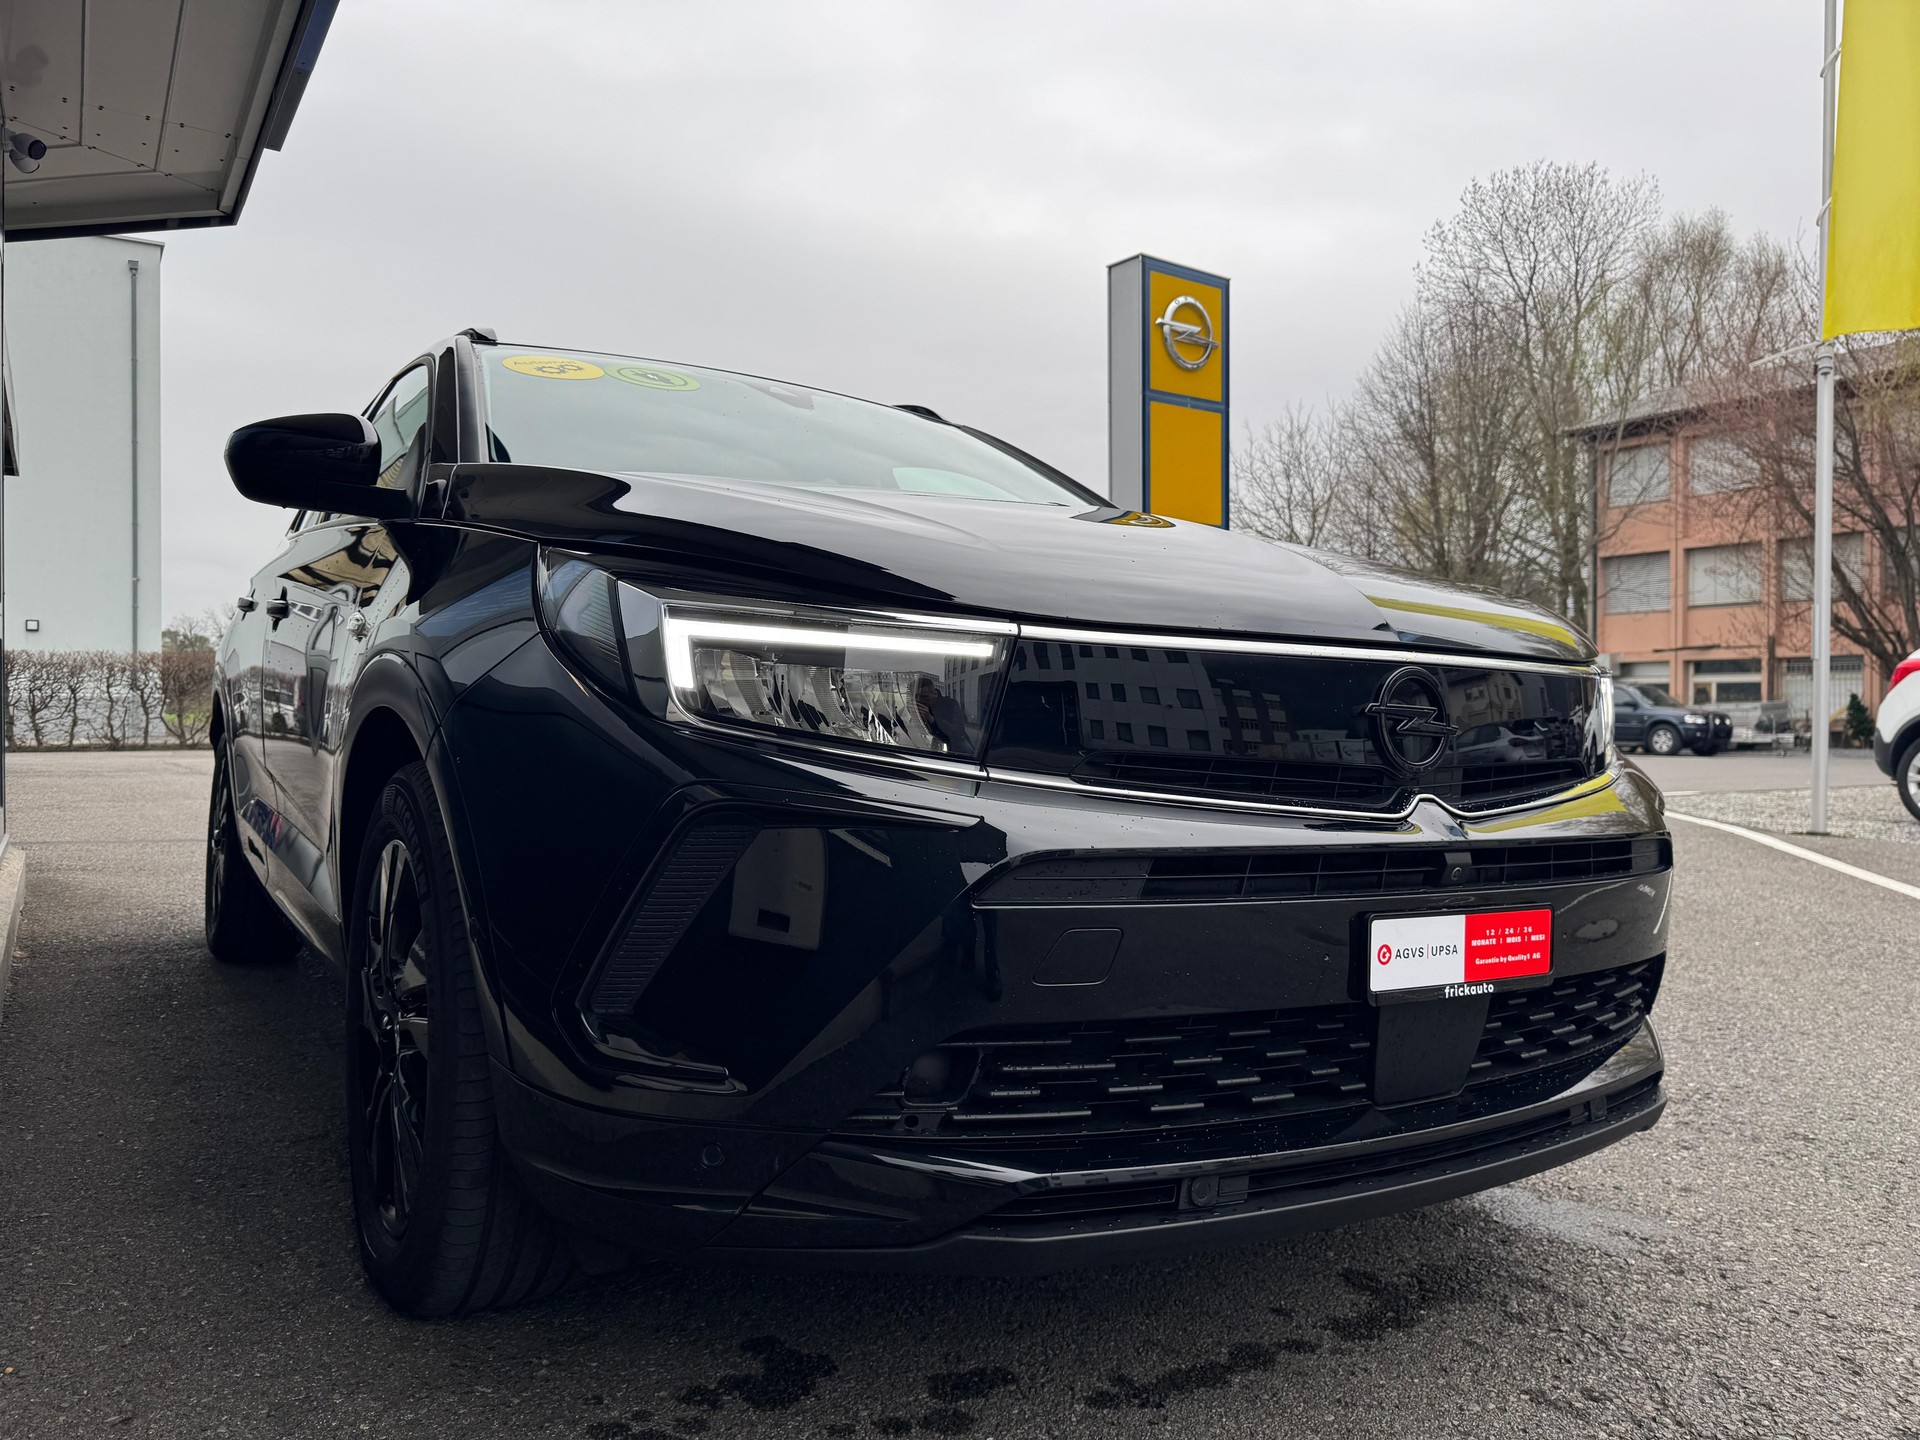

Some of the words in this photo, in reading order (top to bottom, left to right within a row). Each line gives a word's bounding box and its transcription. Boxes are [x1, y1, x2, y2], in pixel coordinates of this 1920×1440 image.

[1505, 927, 1514, 935] 24
[1471, 938, 1497, 947] MONATE
[1394, 946, 1424, 960] AGVS
[1431, 944, 1459, 957] UPSA
[1475, 956, 1500, 965] Garantie
[1499, 955, 1507, 964] by
[1445, 982, 1494, 998] frickauto
